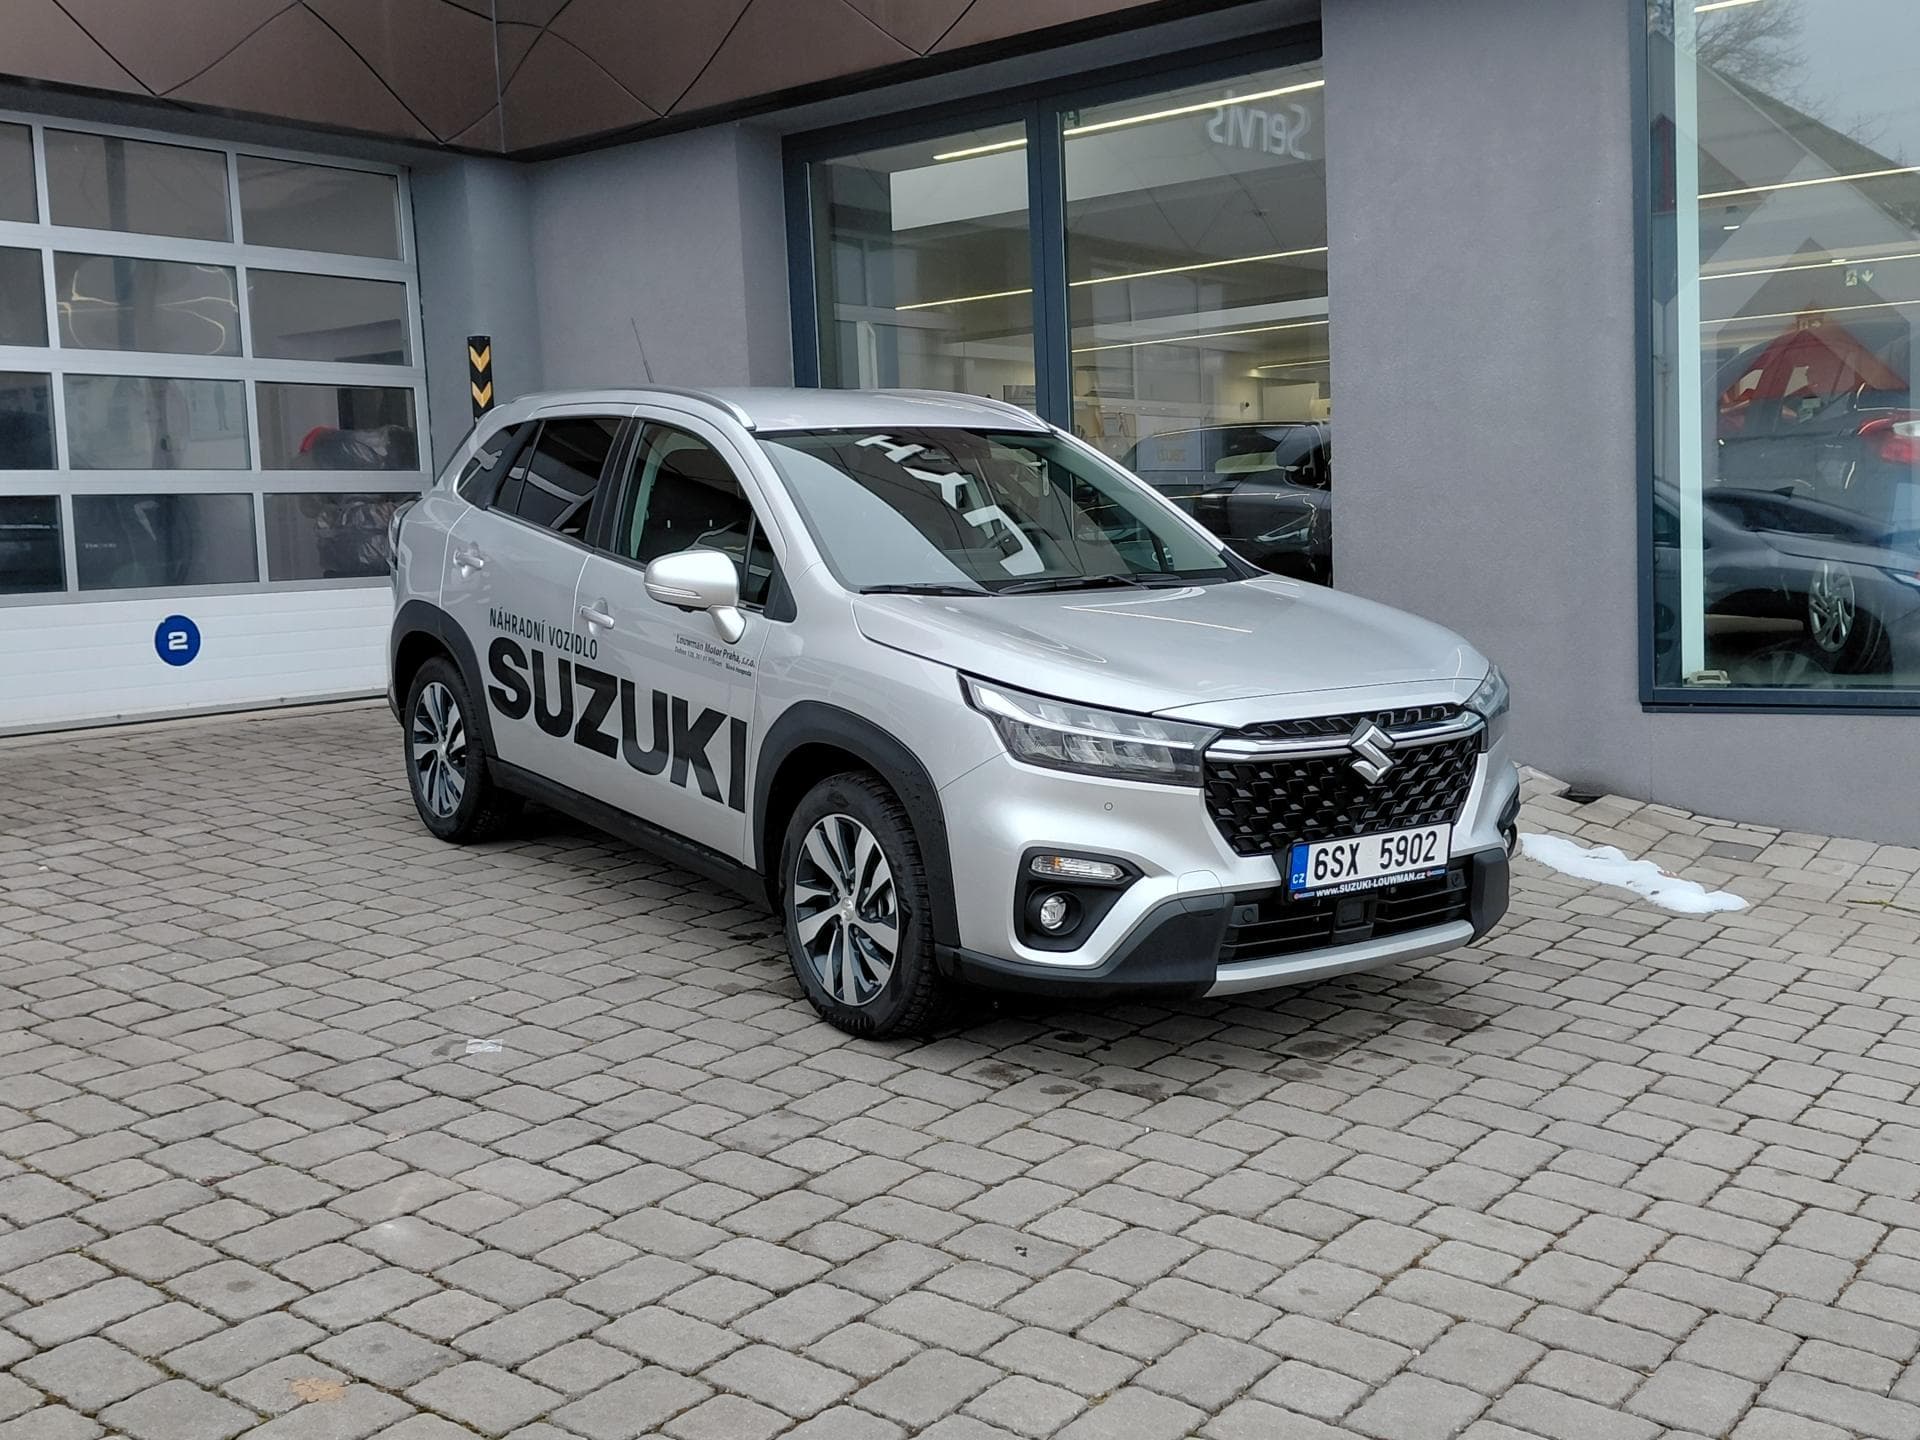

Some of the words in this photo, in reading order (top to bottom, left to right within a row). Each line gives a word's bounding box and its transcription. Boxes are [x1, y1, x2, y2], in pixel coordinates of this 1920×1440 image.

[168, 631, 188, 651] 2
[489, 607, 545, 643] NÁHRADNÍ
[549, 625, 598, 661] VOZIDLO
[705, 642, 723, 657] Motor
[723, 648, 741, 665] Praha,
[487, 636, 748, 814] SUZUKI
[1313, 842, 1361, 881] 6SX
[1379, 830, 1438, 870] 5902
[1292, 872, 1305, 885] CZ
[1316, 871, 1426, 898] www.SUZUKI-LOUWMAN.cz
